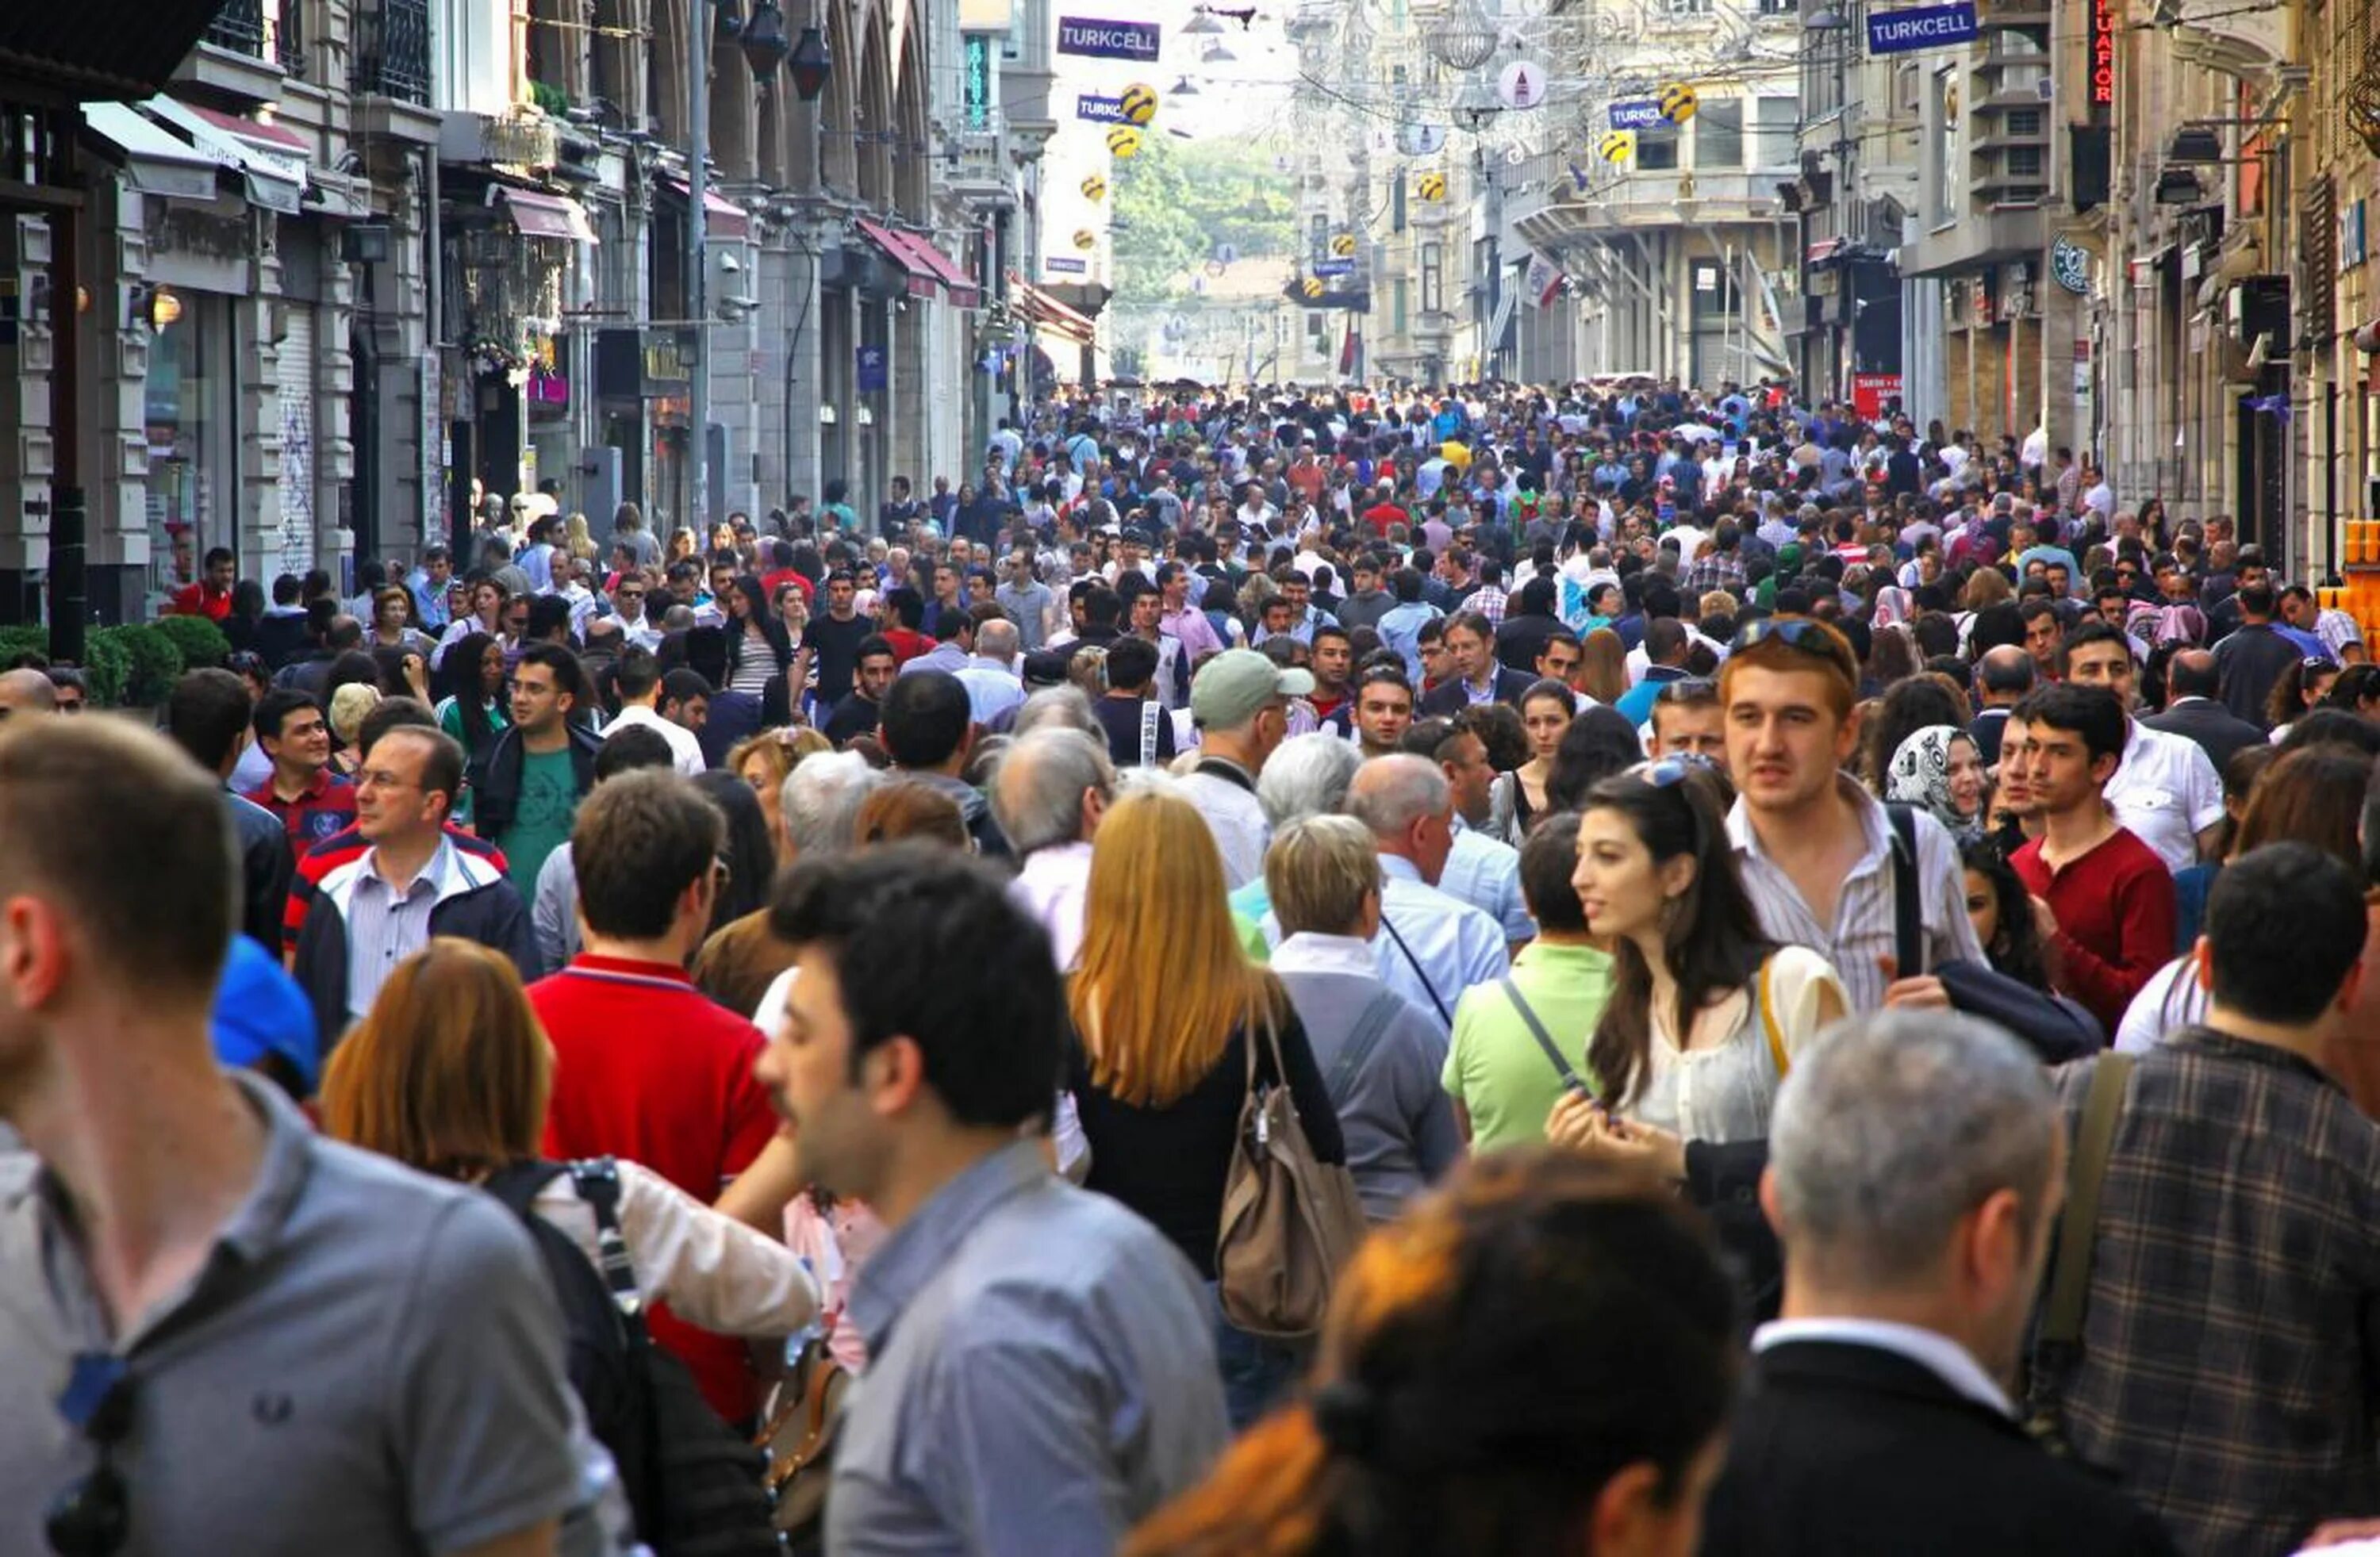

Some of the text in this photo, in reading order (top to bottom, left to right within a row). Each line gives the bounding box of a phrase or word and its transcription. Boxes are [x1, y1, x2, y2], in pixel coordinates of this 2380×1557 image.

[1062, 27, 1155, 51] TURKCELL
[1873, 14, 1970, 43] TURKCELL
[1081, 100, 1123, 117] TURKC
